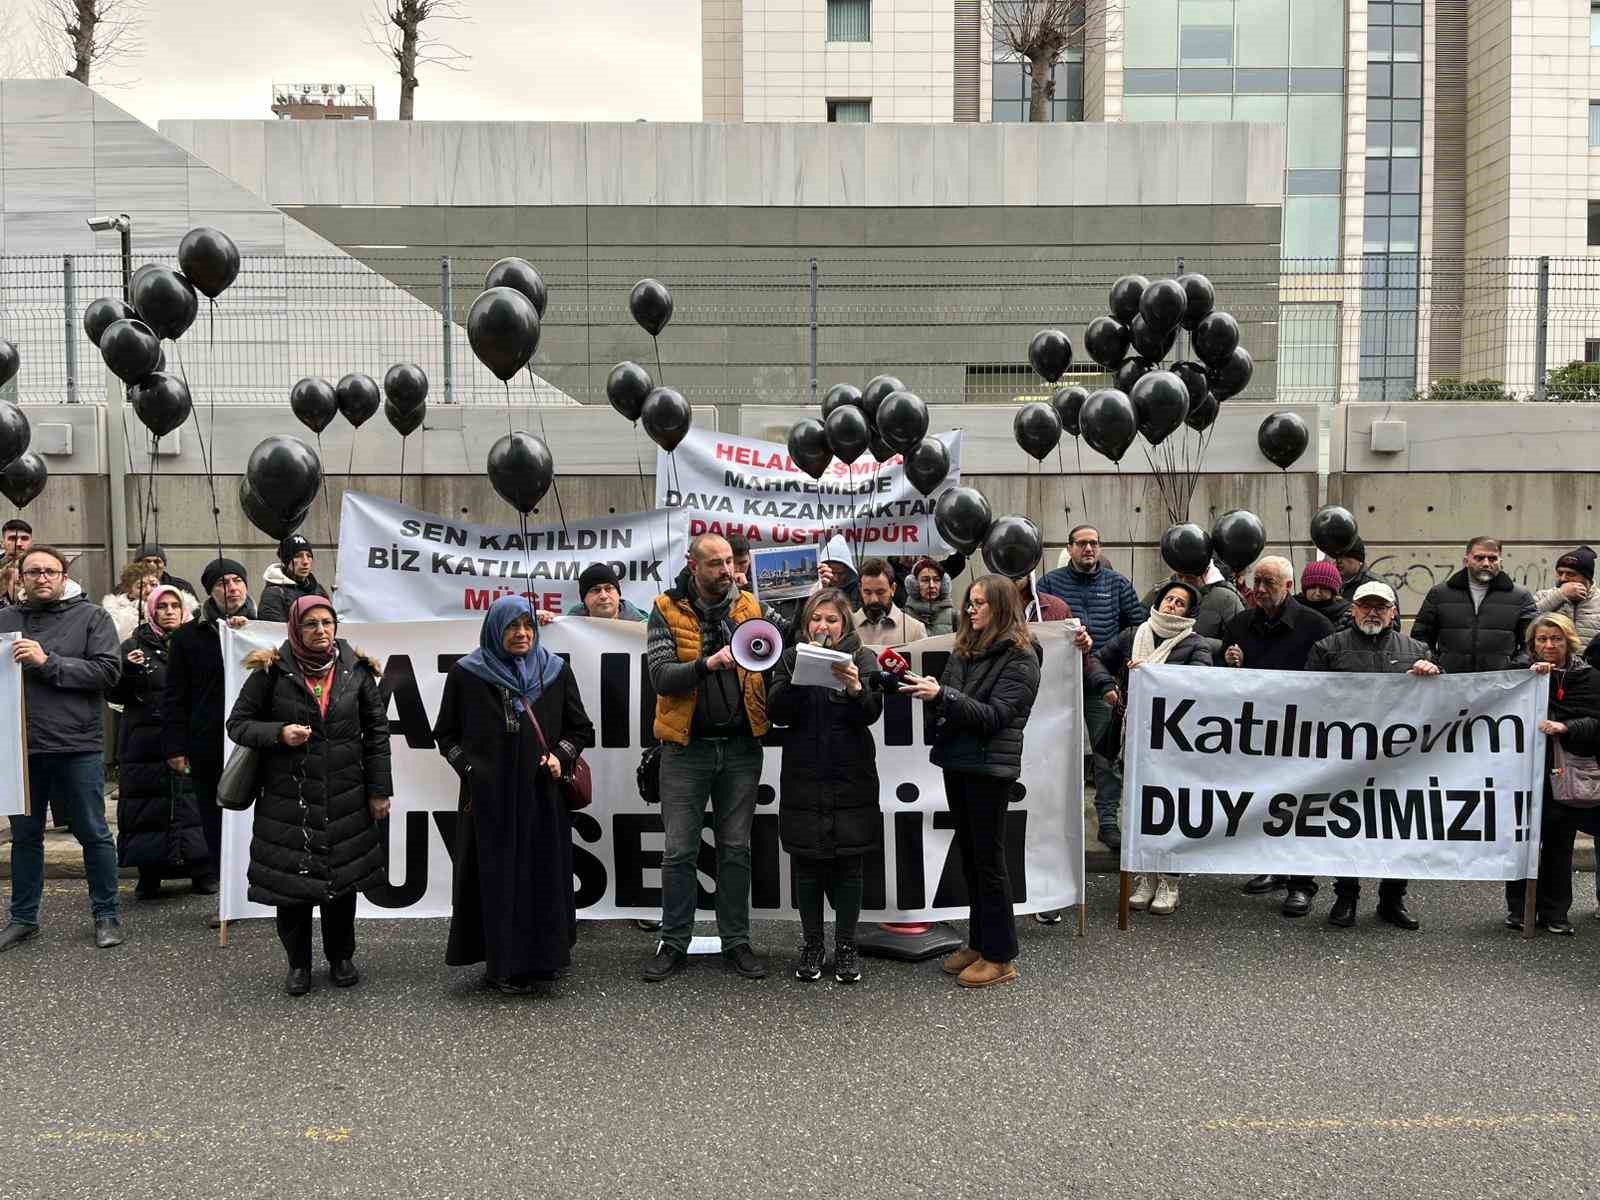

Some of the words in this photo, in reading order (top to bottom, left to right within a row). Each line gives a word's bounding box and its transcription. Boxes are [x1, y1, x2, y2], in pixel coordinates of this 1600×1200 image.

[725, 470, 892, 495] MAHKEMEDE
[665, 490, 733, 513] DAVA
[400, 519, 467, 547] SEN
[479, 528, 632, 551] KATILDIN
[367, 543, 420, 572] BİZ
[431, 552, 664, 581] KATILAMDIK
[1149, 696, 1525, 760] Katılımevim
[1140, 784, 1255, 840] DUY
[1262, 776, 1497, 842] SESİMİZİ
